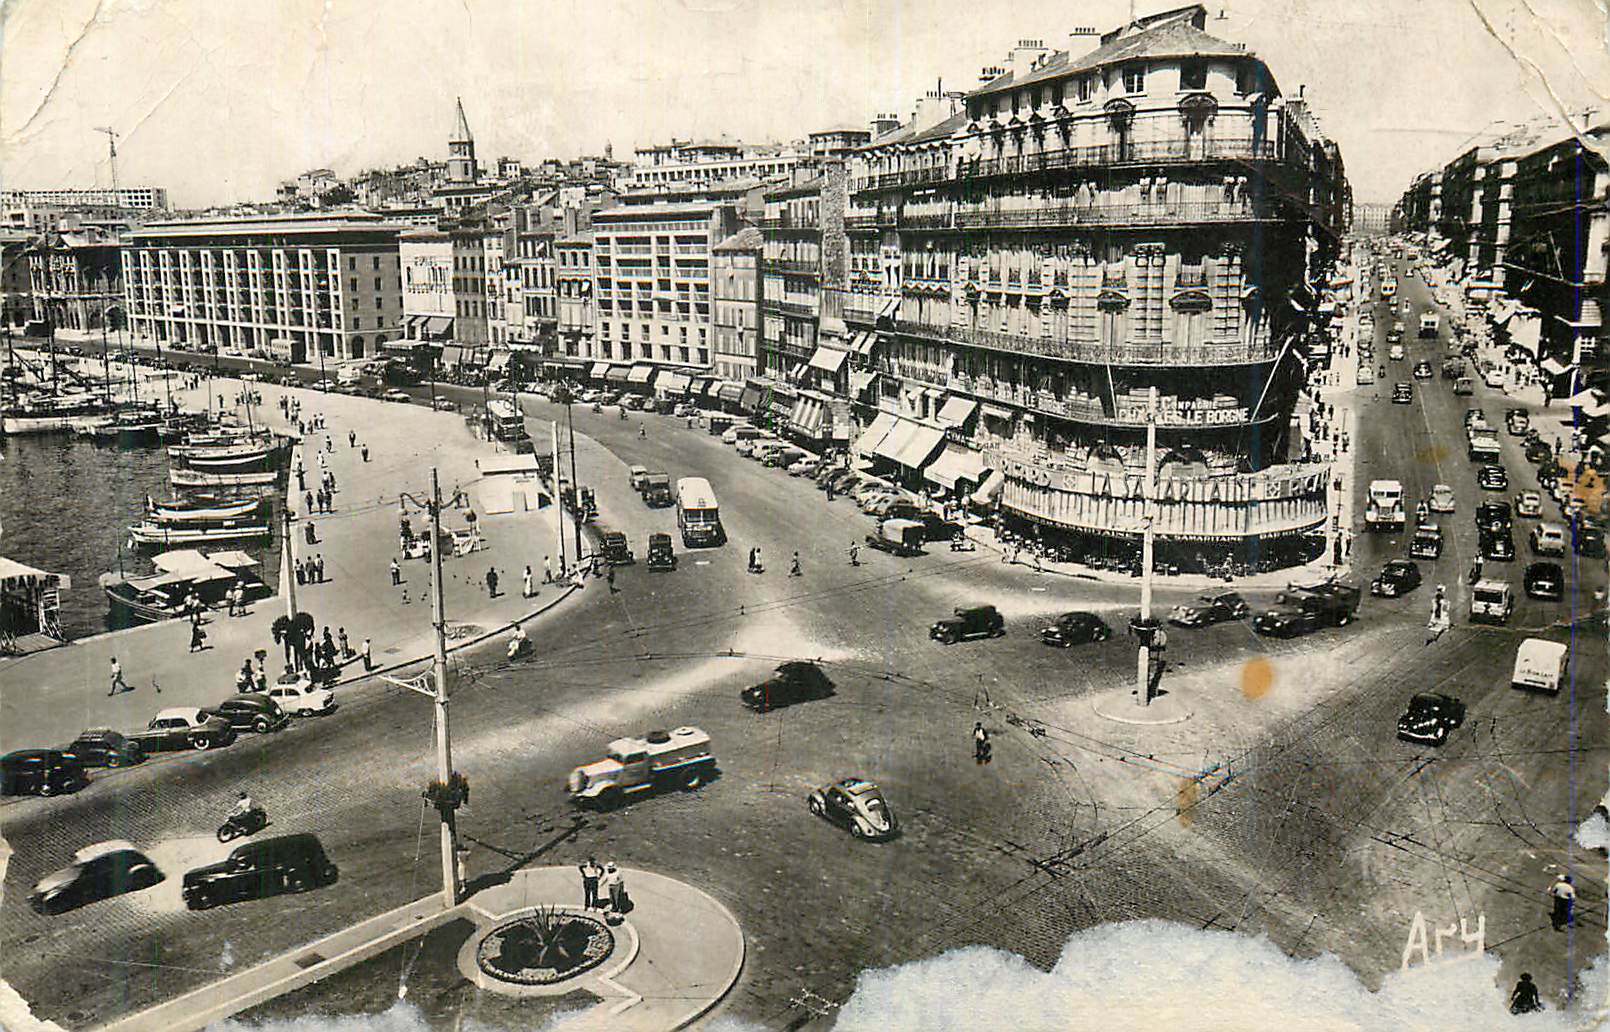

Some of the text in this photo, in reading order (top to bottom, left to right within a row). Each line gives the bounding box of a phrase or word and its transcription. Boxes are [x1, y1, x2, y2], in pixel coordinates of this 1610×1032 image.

[1186, 410, 1204, 425] LE
[1206, 407, 1250, 424] BORGNE
[1092, 471, 1257, 503] LA SAMARITAINE
[1174, 534, 1244, 543] SAMARITAINE
